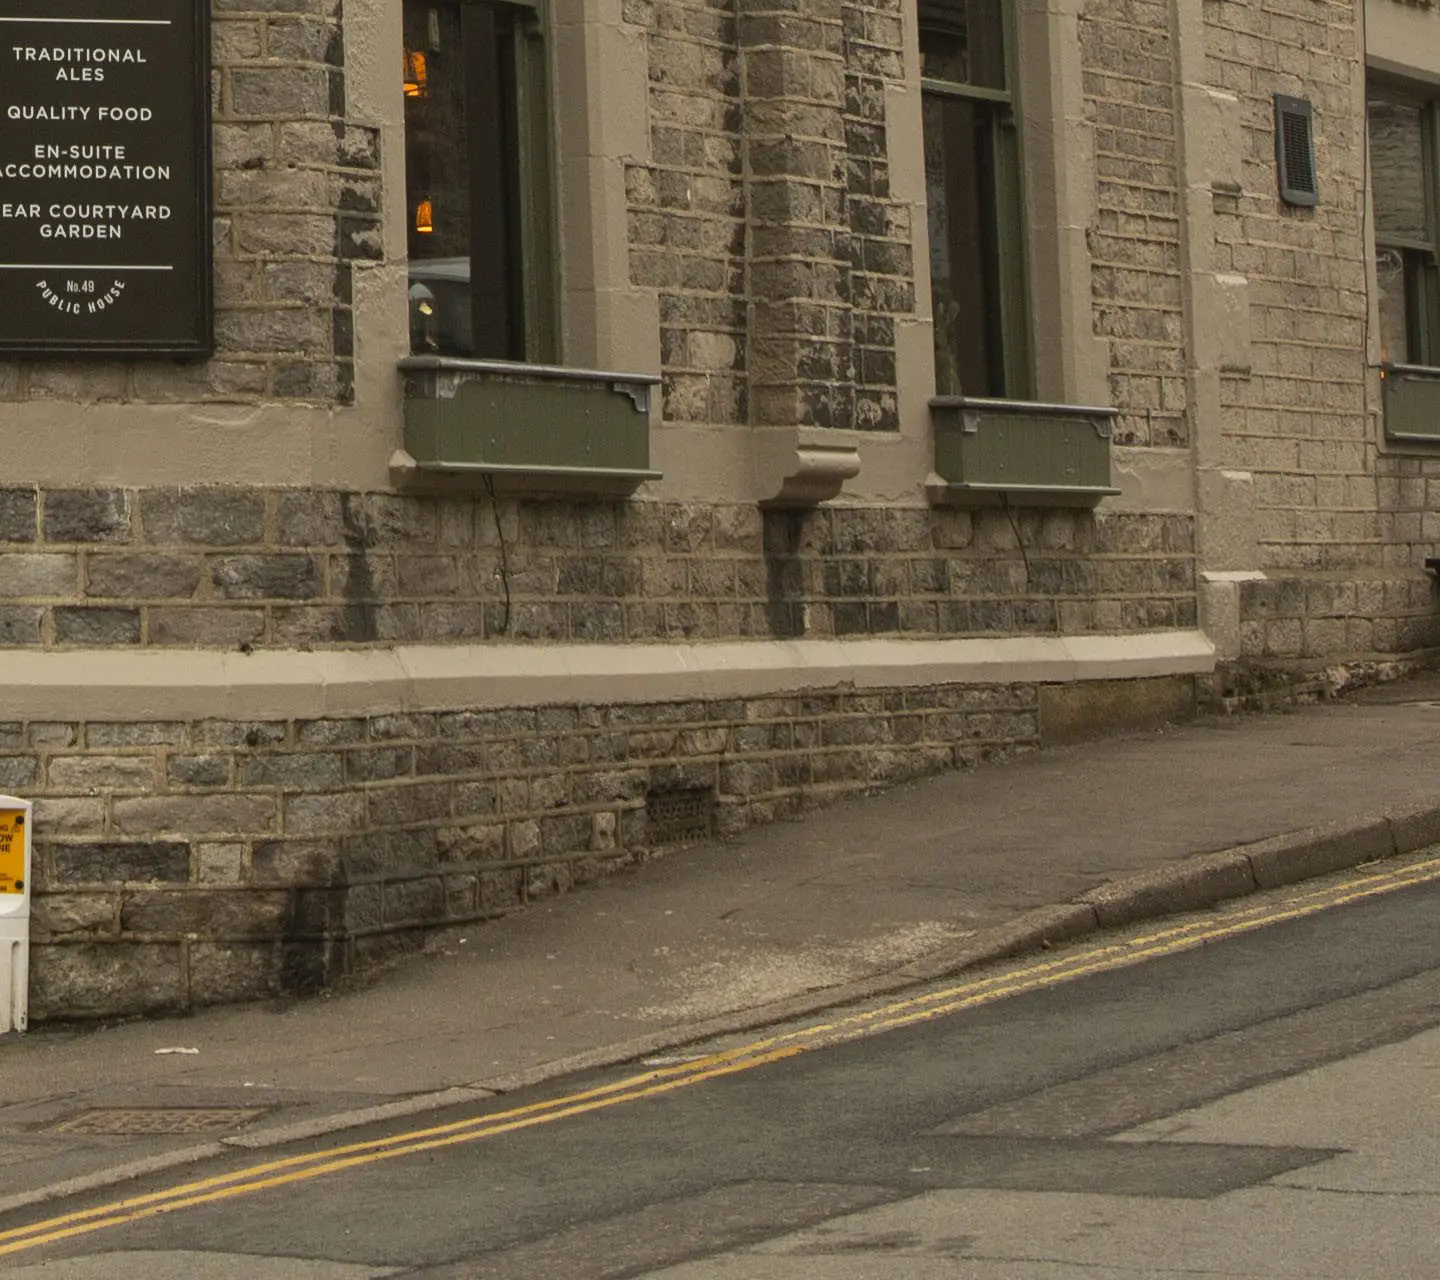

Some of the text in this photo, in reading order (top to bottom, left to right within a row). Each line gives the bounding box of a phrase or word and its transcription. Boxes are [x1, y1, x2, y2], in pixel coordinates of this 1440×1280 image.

[13, 47, 146, 63] TRADITIONAL
[55, 68, 105, 81] ALES
[7, 106, 152, 121] QUALITY FOOD
[34, 145, 126, 159] EN-SUITE
[49, 204, 171, 220] COURTYARD
[39, 224, 122, 239] GARDEN
[36, 280, 126, 315] PUBLIC HOUSE
